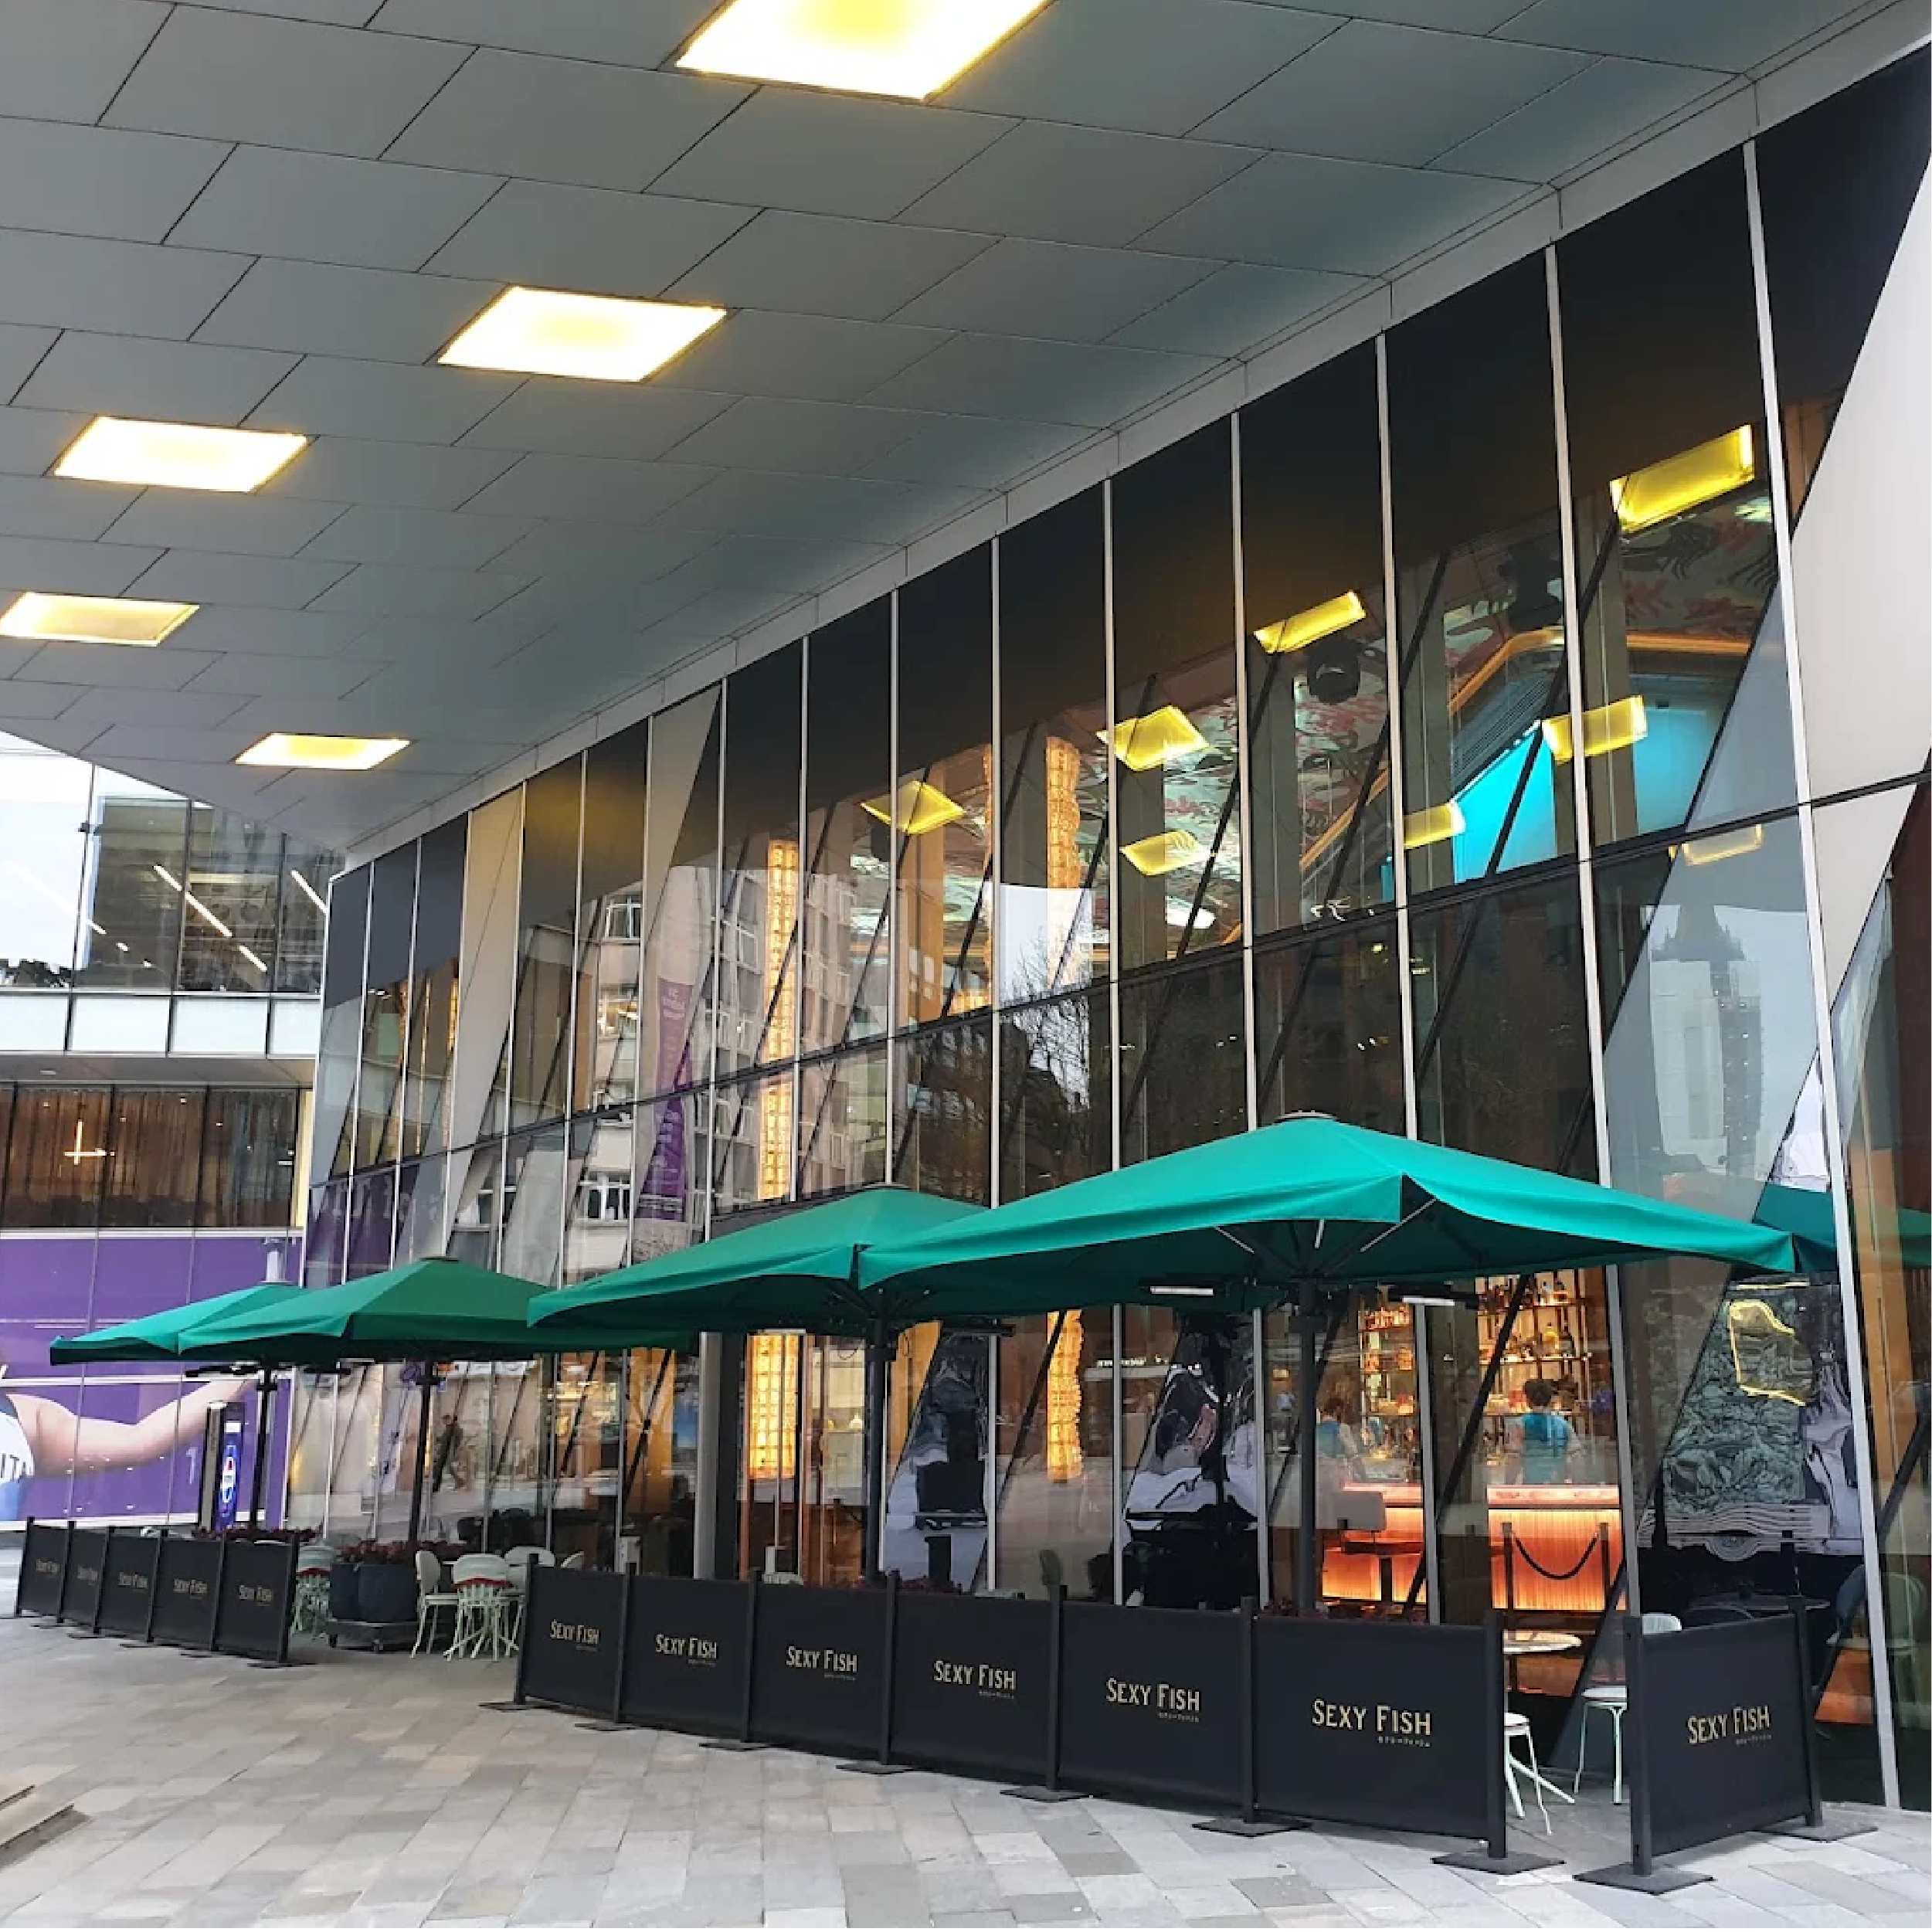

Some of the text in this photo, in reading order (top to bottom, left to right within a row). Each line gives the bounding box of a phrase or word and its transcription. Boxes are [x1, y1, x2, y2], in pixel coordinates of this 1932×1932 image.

[656, 1633, 717, 1659] SEXY FISH
[786, 1645, 857, 1672] SEXY FISH
[933, 1660, 1017, 1689] SEXY FISH
[1106, 1677, 1200, 1711] SEXY FISH
[1312, 1699, 1431, 1736] SEXY FISH
[1687, 1704, 1770, 1744] SEXY FISH
